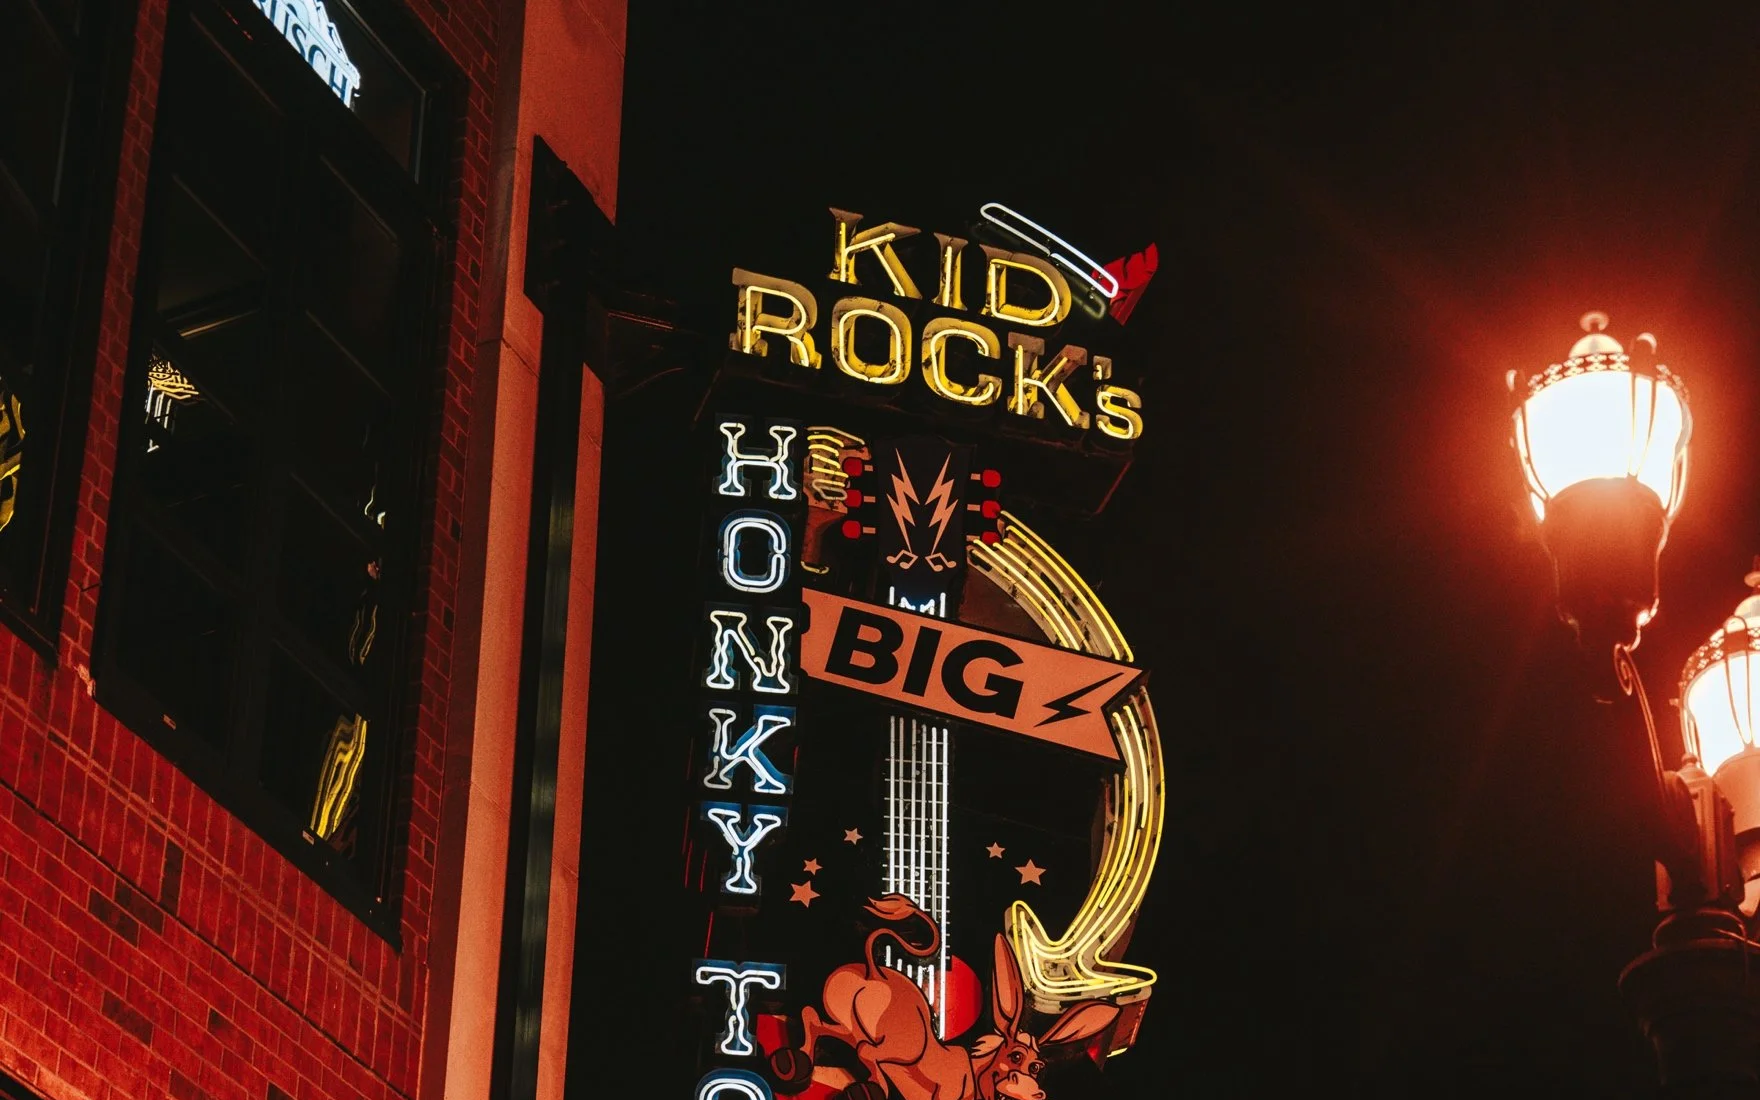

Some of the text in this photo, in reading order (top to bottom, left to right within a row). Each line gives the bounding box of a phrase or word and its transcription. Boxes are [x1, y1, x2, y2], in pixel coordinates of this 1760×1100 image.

[259, 0, 347, 103] USCH
[829, 207, 1072, 327] KID
[703, 421, 798, 895] HONKY
[824, 606, 1025, 720] BIG
